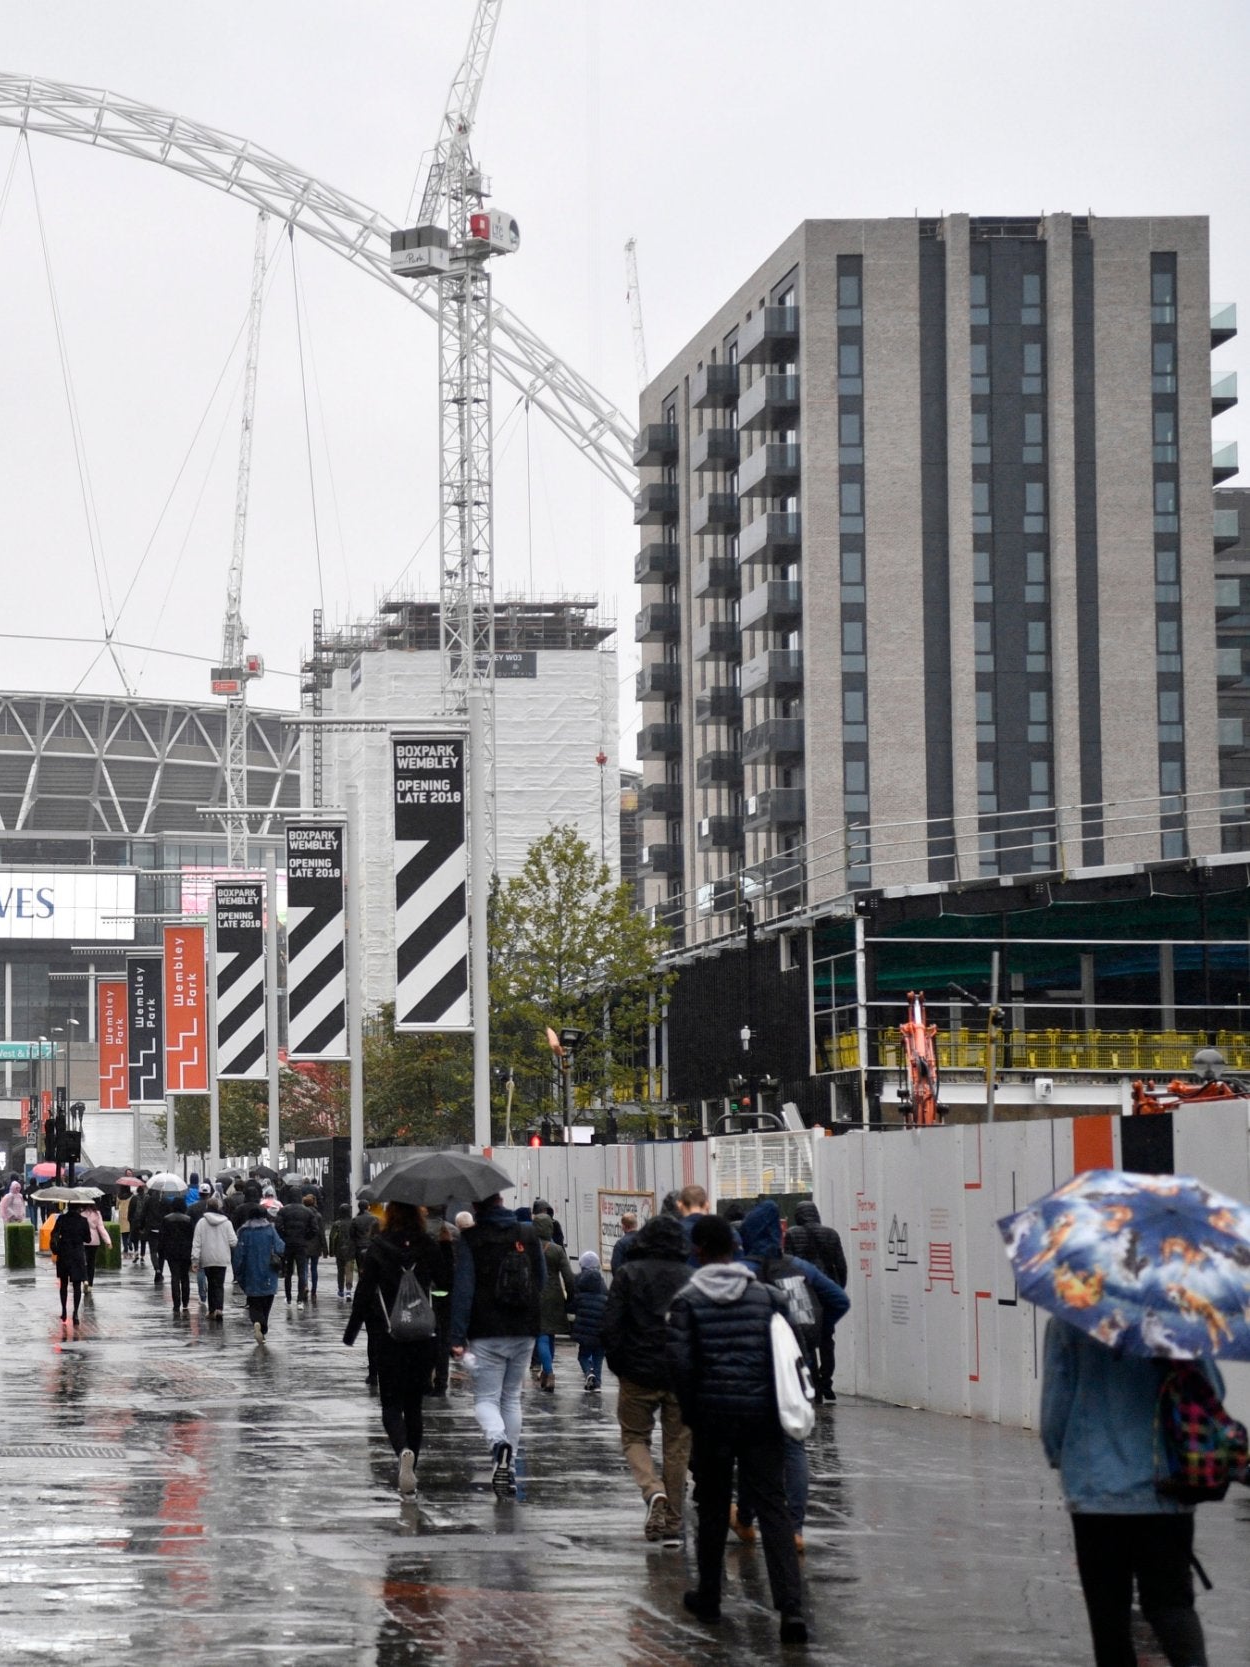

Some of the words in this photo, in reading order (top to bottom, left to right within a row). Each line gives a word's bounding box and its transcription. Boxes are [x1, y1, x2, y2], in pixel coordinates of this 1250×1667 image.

[396, 745, 455, 757] BOXPARK
[397, 756, 459, 769] WEMBLEY
[397, 779, 450, 791] OPENING
[397, 791, 427, 803] LATE
[430, 791, 461, 803] 2018
[288, 830, 336, 840] BOXPARK
[289, 840, 339, 850] WEMBLEY
[289, 858, 332, 868] OPENING
[289, 868, 314, 878] LATE
[315, 868, 341, 878] 2018
[217, 888, 257, 897] BOXPARK
[217, 896, 259, 905] WEMBLEY
[217, 911, 254, 920] OPENING
[217, 920, 238, 928] LATE
[239, 920, 261, 928] 2018
[173, 938, 185, 1006] Wembley
[187, 973, 197, 1006] Park
[135, 967, 146, 1028] Wembley
[105, 991, 115, 1044] Wembley
[147, 999, 156, 1028] Park
[116, 1018, 124, 1044] Park
[17, 1050, 25, 1058] &
